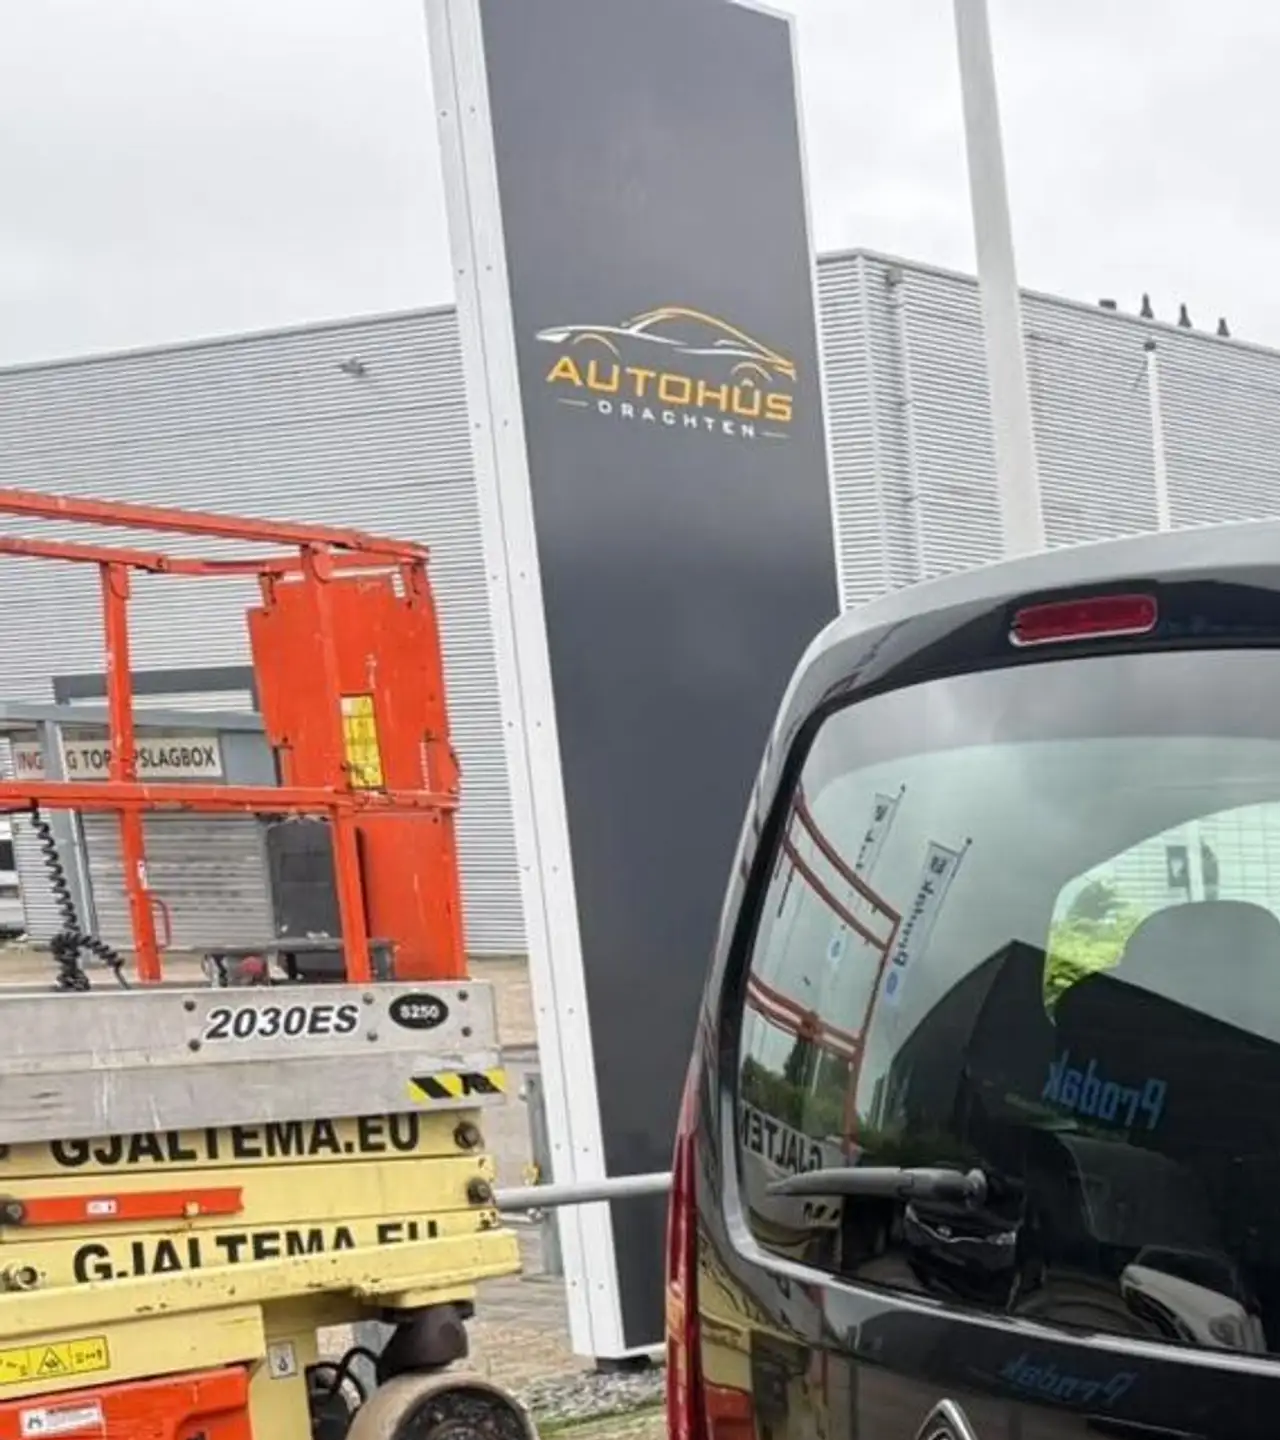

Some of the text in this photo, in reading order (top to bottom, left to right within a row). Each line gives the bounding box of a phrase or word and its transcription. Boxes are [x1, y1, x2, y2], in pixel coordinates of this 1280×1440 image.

[546, 356, 793, 422] AUTOHÛS
[597, 400, 756, 438] DRACHTEN
[205, 1004, 358, 1040] 2030ES
[50, 1112, 420, 1168] GJALTEMA.EU
[73, 1220, 439, 1284] GJALTEMAEU
